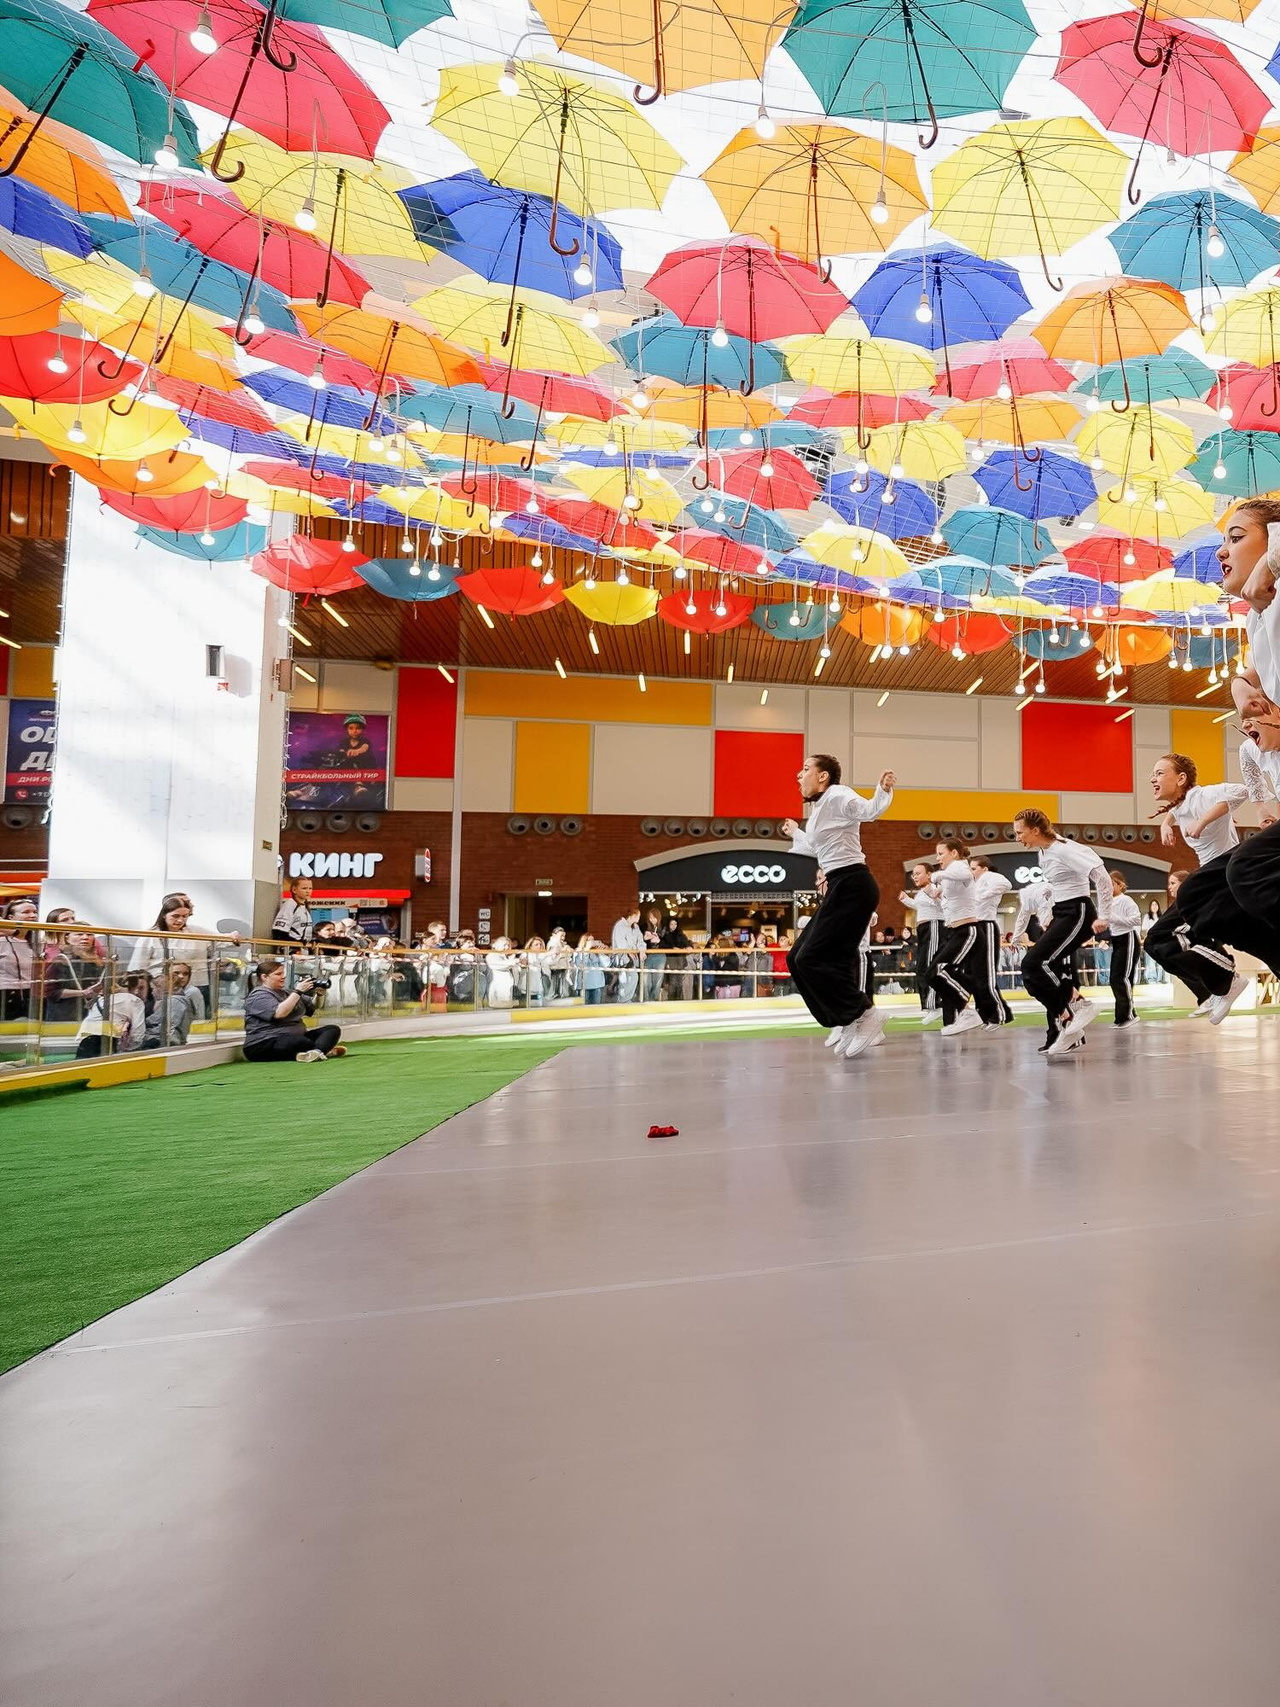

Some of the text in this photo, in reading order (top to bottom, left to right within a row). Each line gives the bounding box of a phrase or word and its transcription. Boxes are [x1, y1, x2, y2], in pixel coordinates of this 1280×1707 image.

[291, 772, 361, 780] СТРАЙКБОЛЬНЫЙ
[289, 852, 384, 878] КИНГ
[721, 865, 786, 883] ecco
